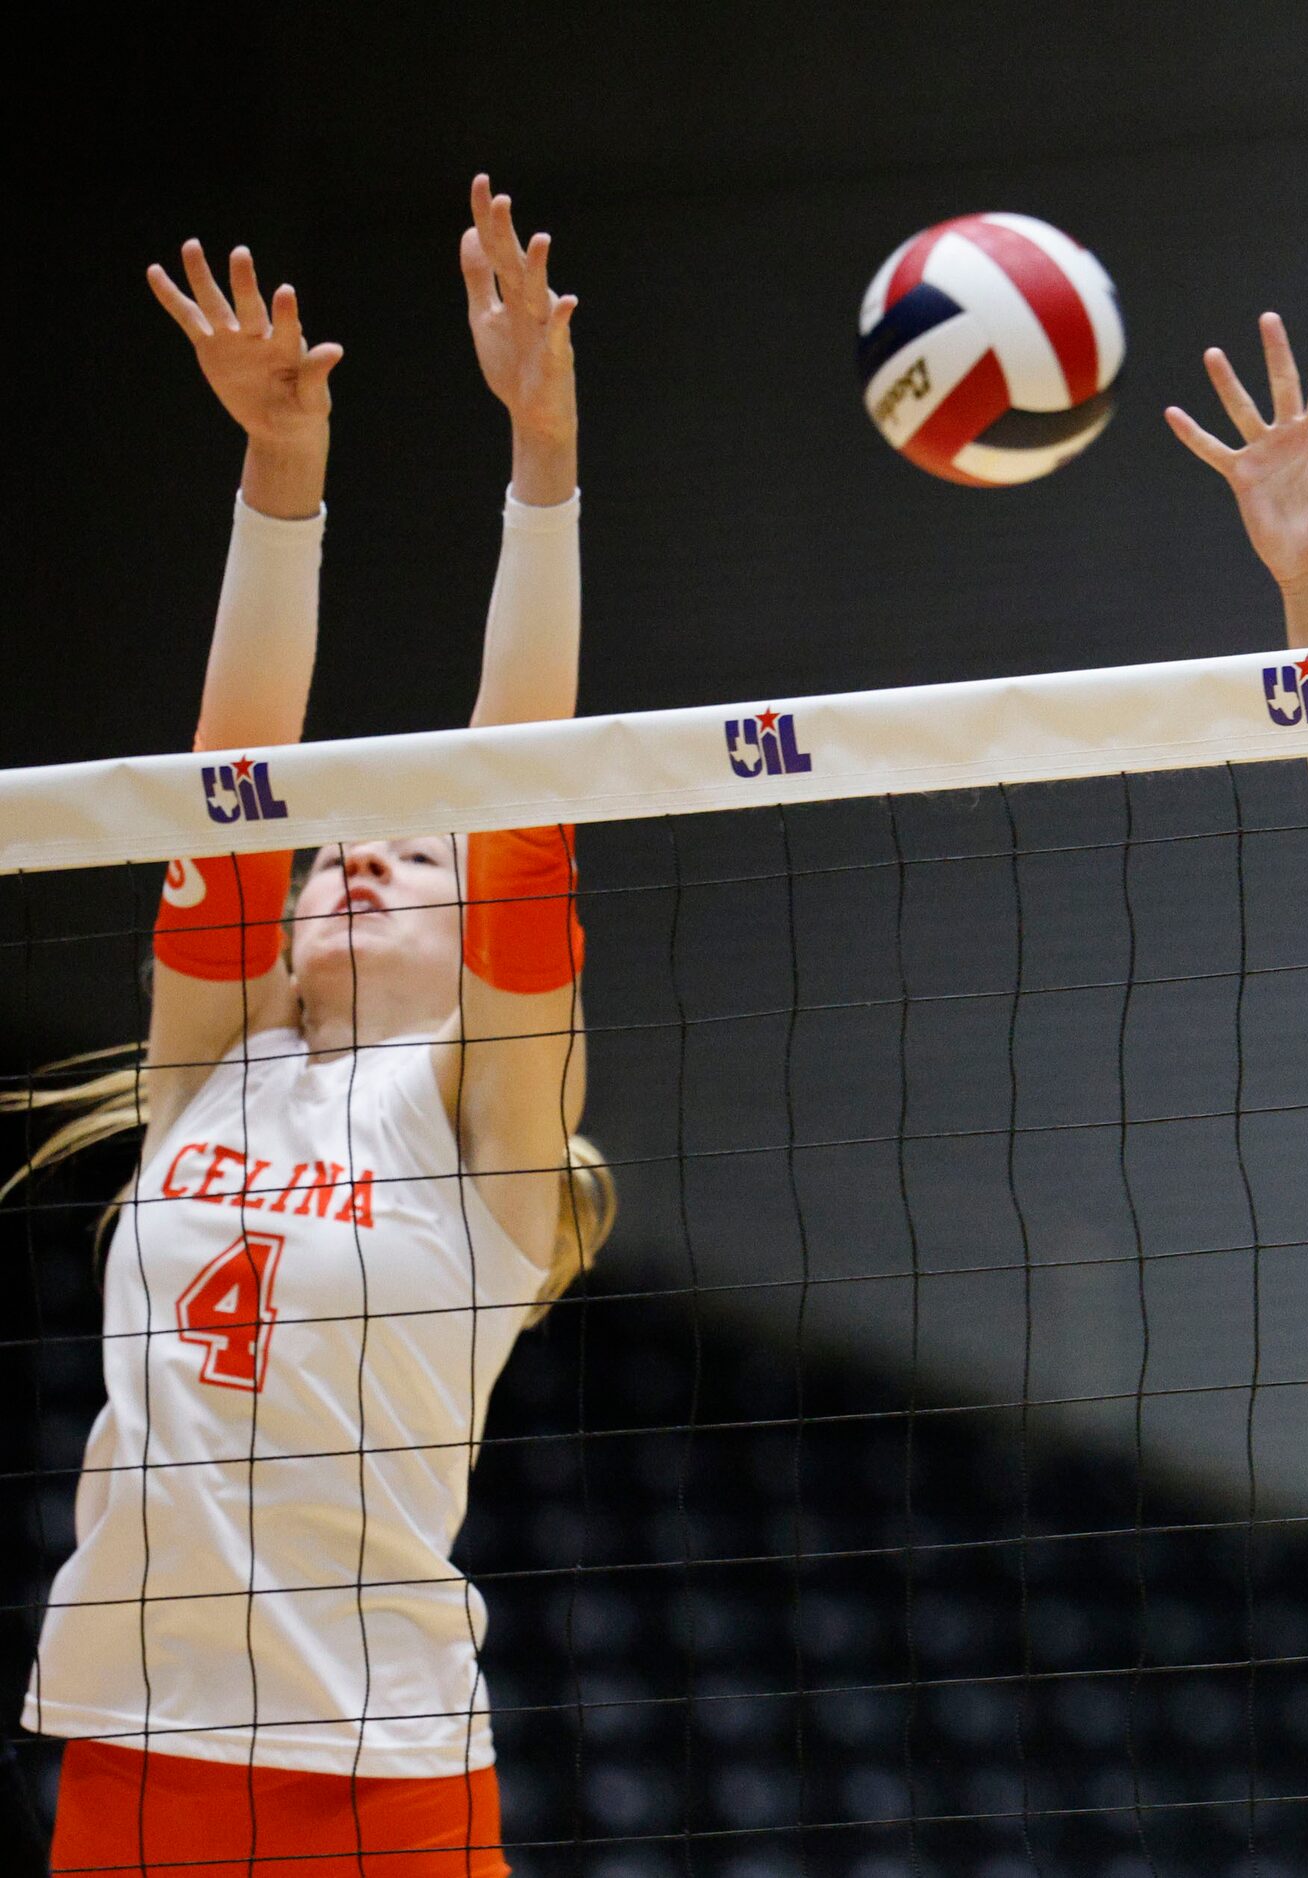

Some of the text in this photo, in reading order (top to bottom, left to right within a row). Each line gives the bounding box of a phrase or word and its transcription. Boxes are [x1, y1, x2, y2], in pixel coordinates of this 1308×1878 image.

[725, 707, 812, 778] UIL
[201, 756, 288, 824] UIL
[162, 1143, 374, 1229] CELINA
[175, 1231, 286, 1393] 4
